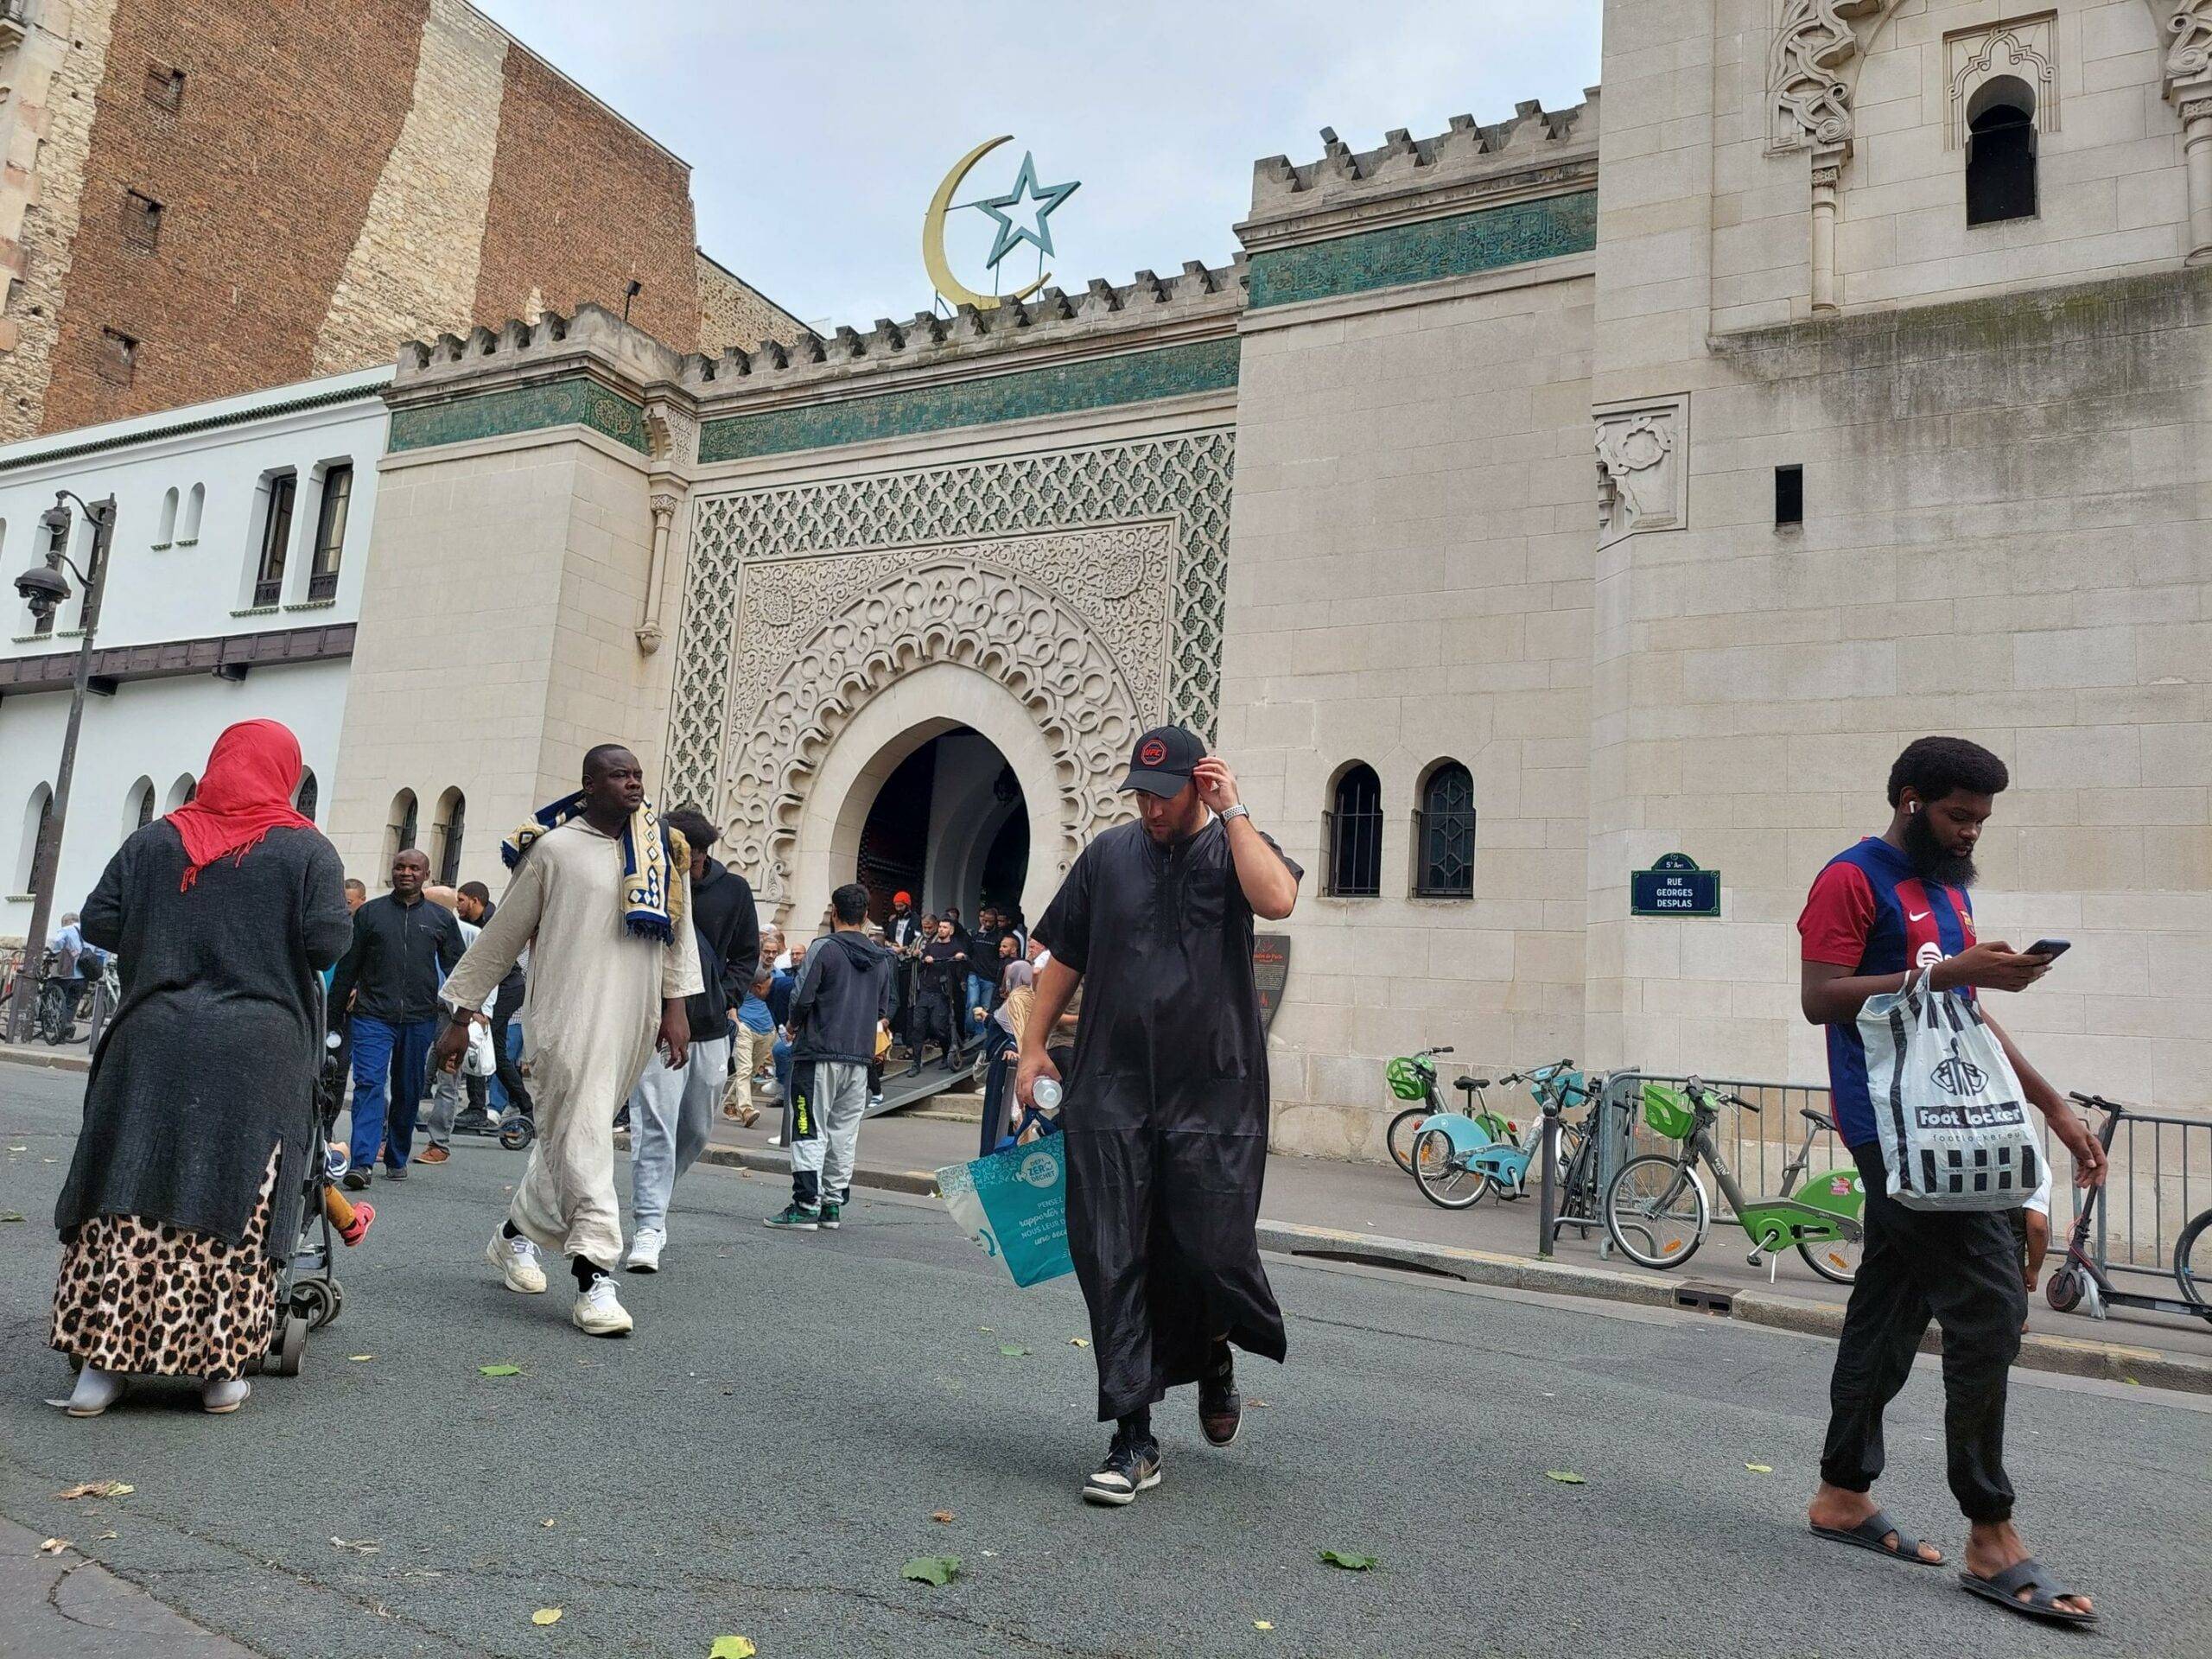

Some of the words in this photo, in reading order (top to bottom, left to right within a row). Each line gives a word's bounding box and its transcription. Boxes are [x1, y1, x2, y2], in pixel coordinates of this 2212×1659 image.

[1656, 888, 1694, 897] GEORGES
[1037, 1196, 1063, 1210] PENSEZ
[1021, 1225, 1041, 1239] NOUS
[1041, 1220, 1059, 1230] LEUR
